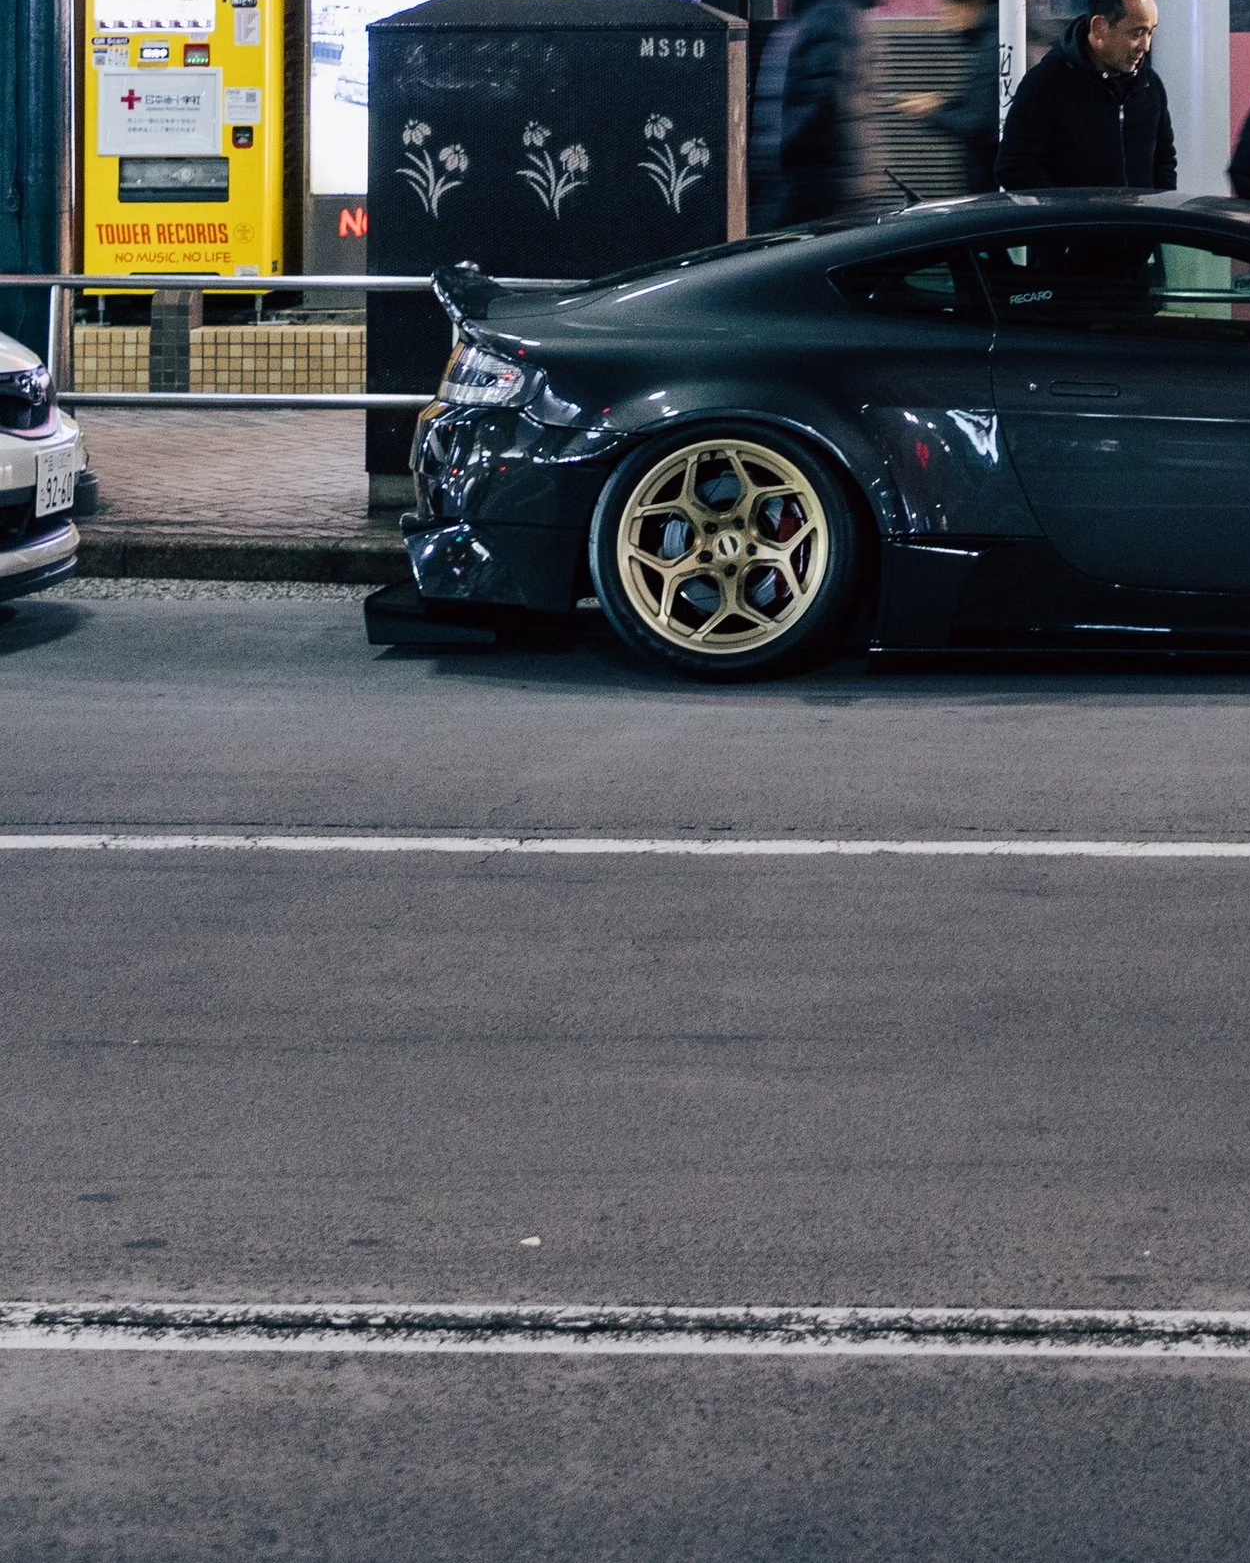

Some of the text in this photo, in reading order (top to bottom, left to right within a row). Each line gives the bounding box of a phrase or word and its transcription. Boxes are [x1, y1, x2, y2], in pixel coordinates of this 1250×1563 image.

[96, 223, 152, 246] TOWER
[156, 222, 229, 245] RECORDS
[115, 252, 134, 264] NO
[183, 252, 201, 263] NO
[1010, 290, 1053, 305] RECARO
